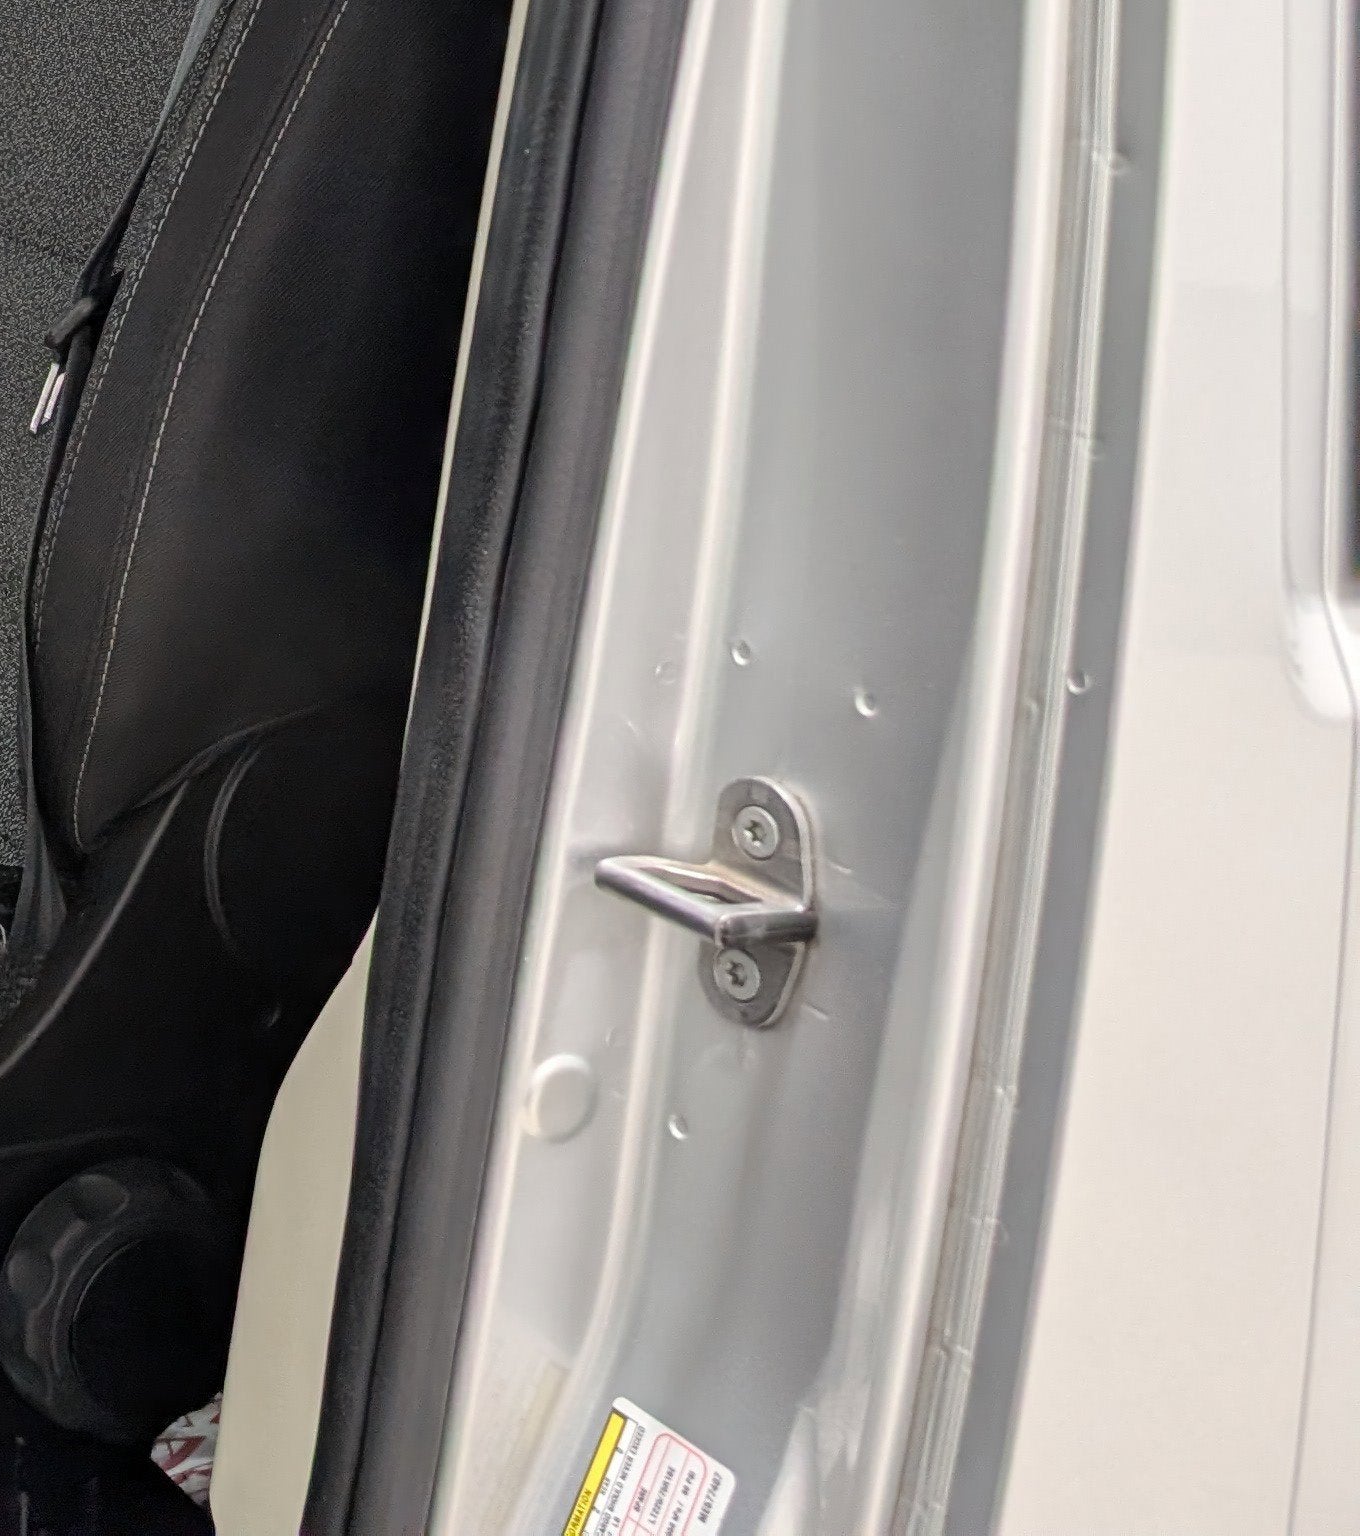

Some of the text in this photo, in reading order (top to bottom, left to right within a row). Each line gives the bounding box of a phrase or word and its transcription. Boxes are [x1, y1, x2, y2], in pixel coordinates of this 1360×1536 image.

[608, 1480, 624, 1512] SHOULD
[620, 1454, 634, 1482] NEVER
[630, 1424, 646, 1455] EXCEED
[566, 1488, 592, 1536] ORMATION
[634, 1486, 648, 1512] SPARE
